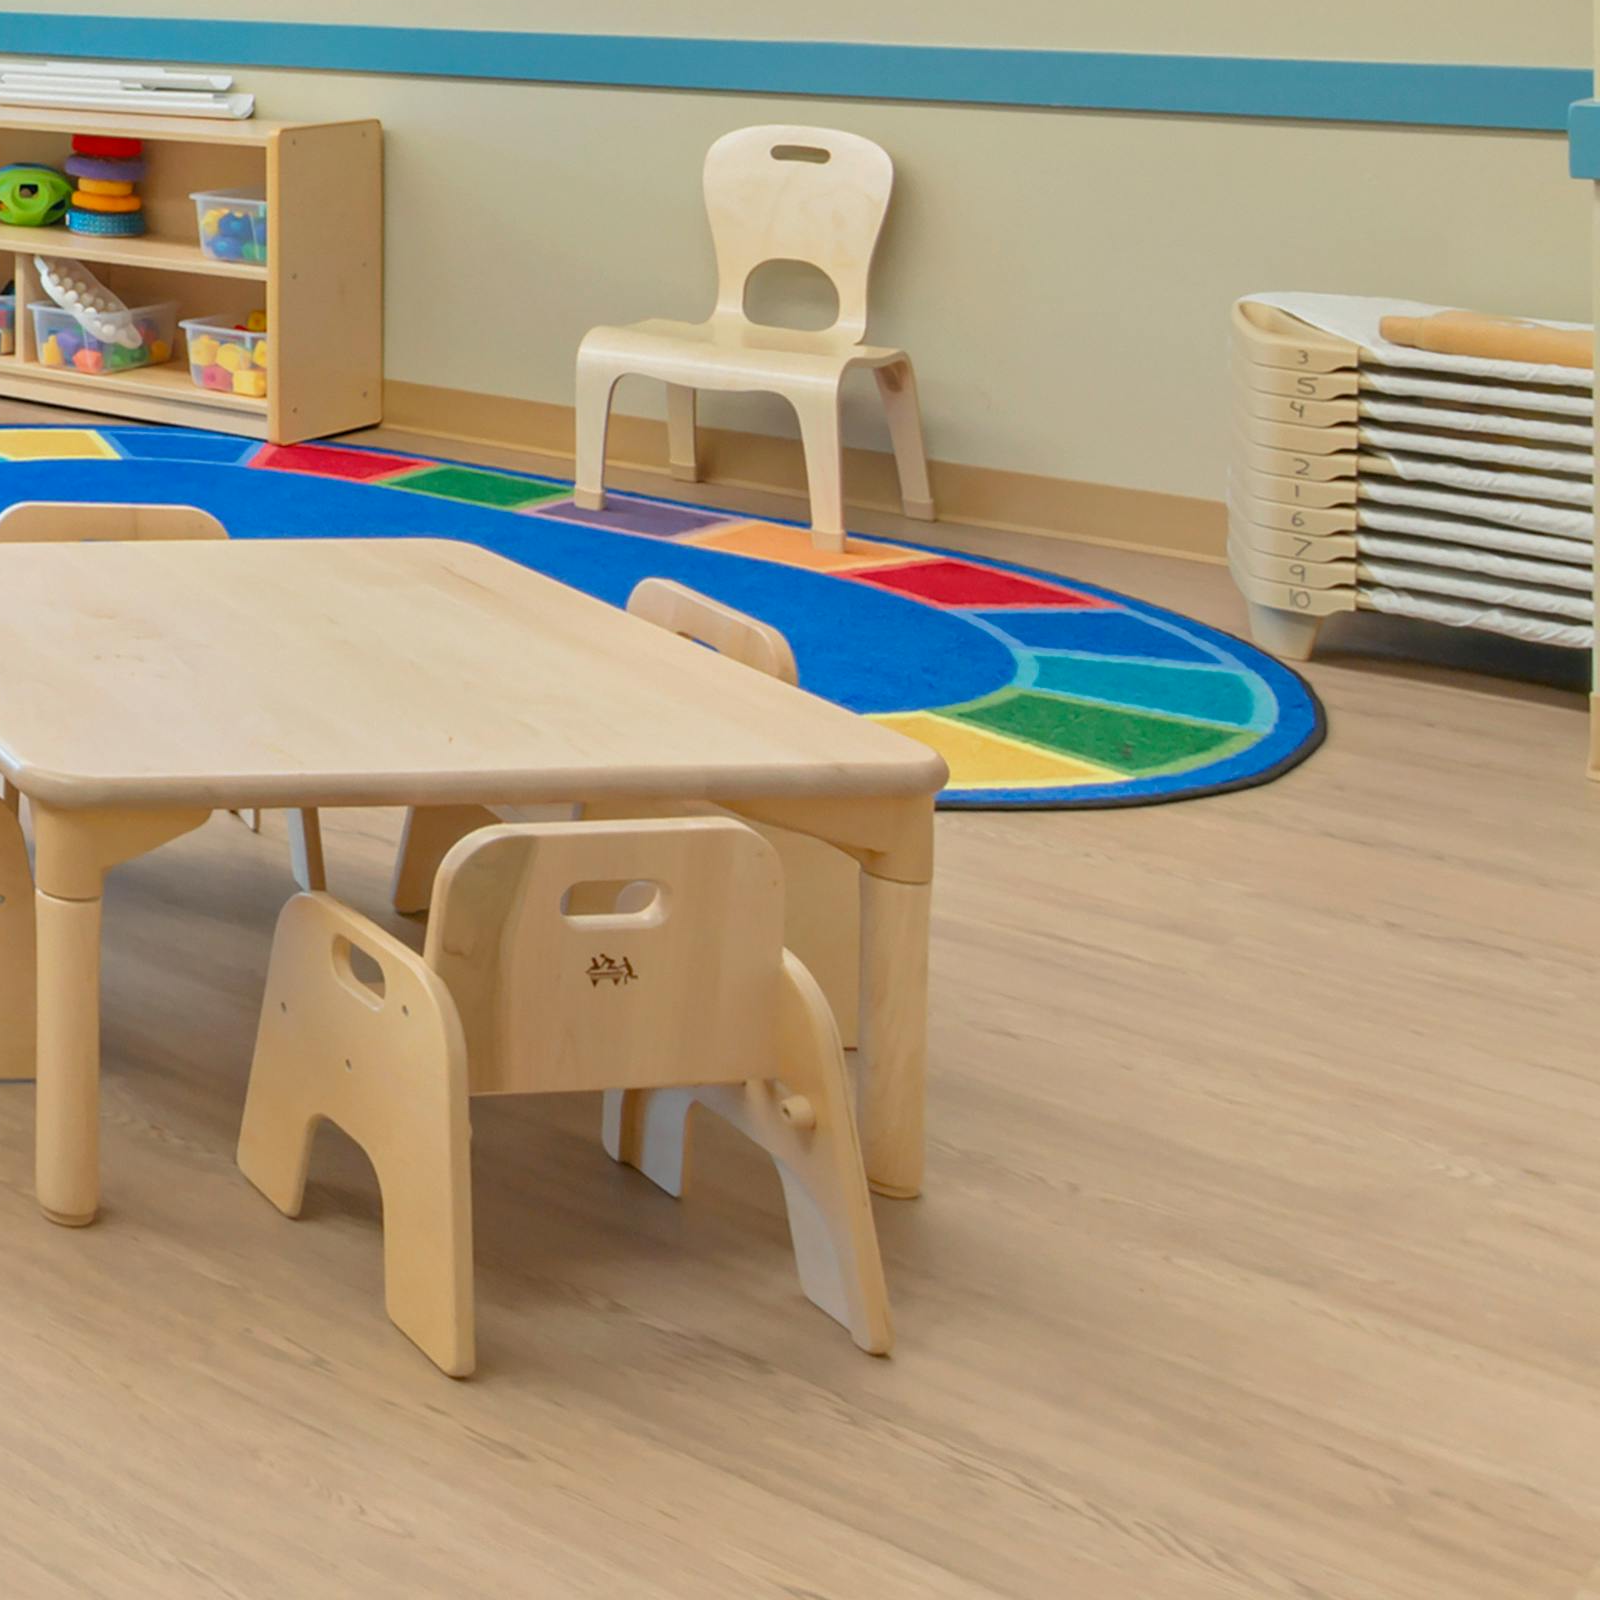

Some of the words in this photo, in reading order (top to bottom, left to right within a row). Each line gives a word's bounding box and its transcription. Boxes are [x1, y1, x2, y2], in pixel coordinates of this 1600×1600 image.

[1297, 349, 1309, 365] 3
[1297, 376, 1318, 395] 5
[1289, 401, 1304, 418] 4
[1294, 457, 1310, 476] 2
[1294, 484, 1300, 498] 1
[1291, 510, 1305, 527] 6
[1293, 536, 1312, 556] 7
[1289, 564, 1305, 582] 9
[1289, 587, 1311, 609] 10
